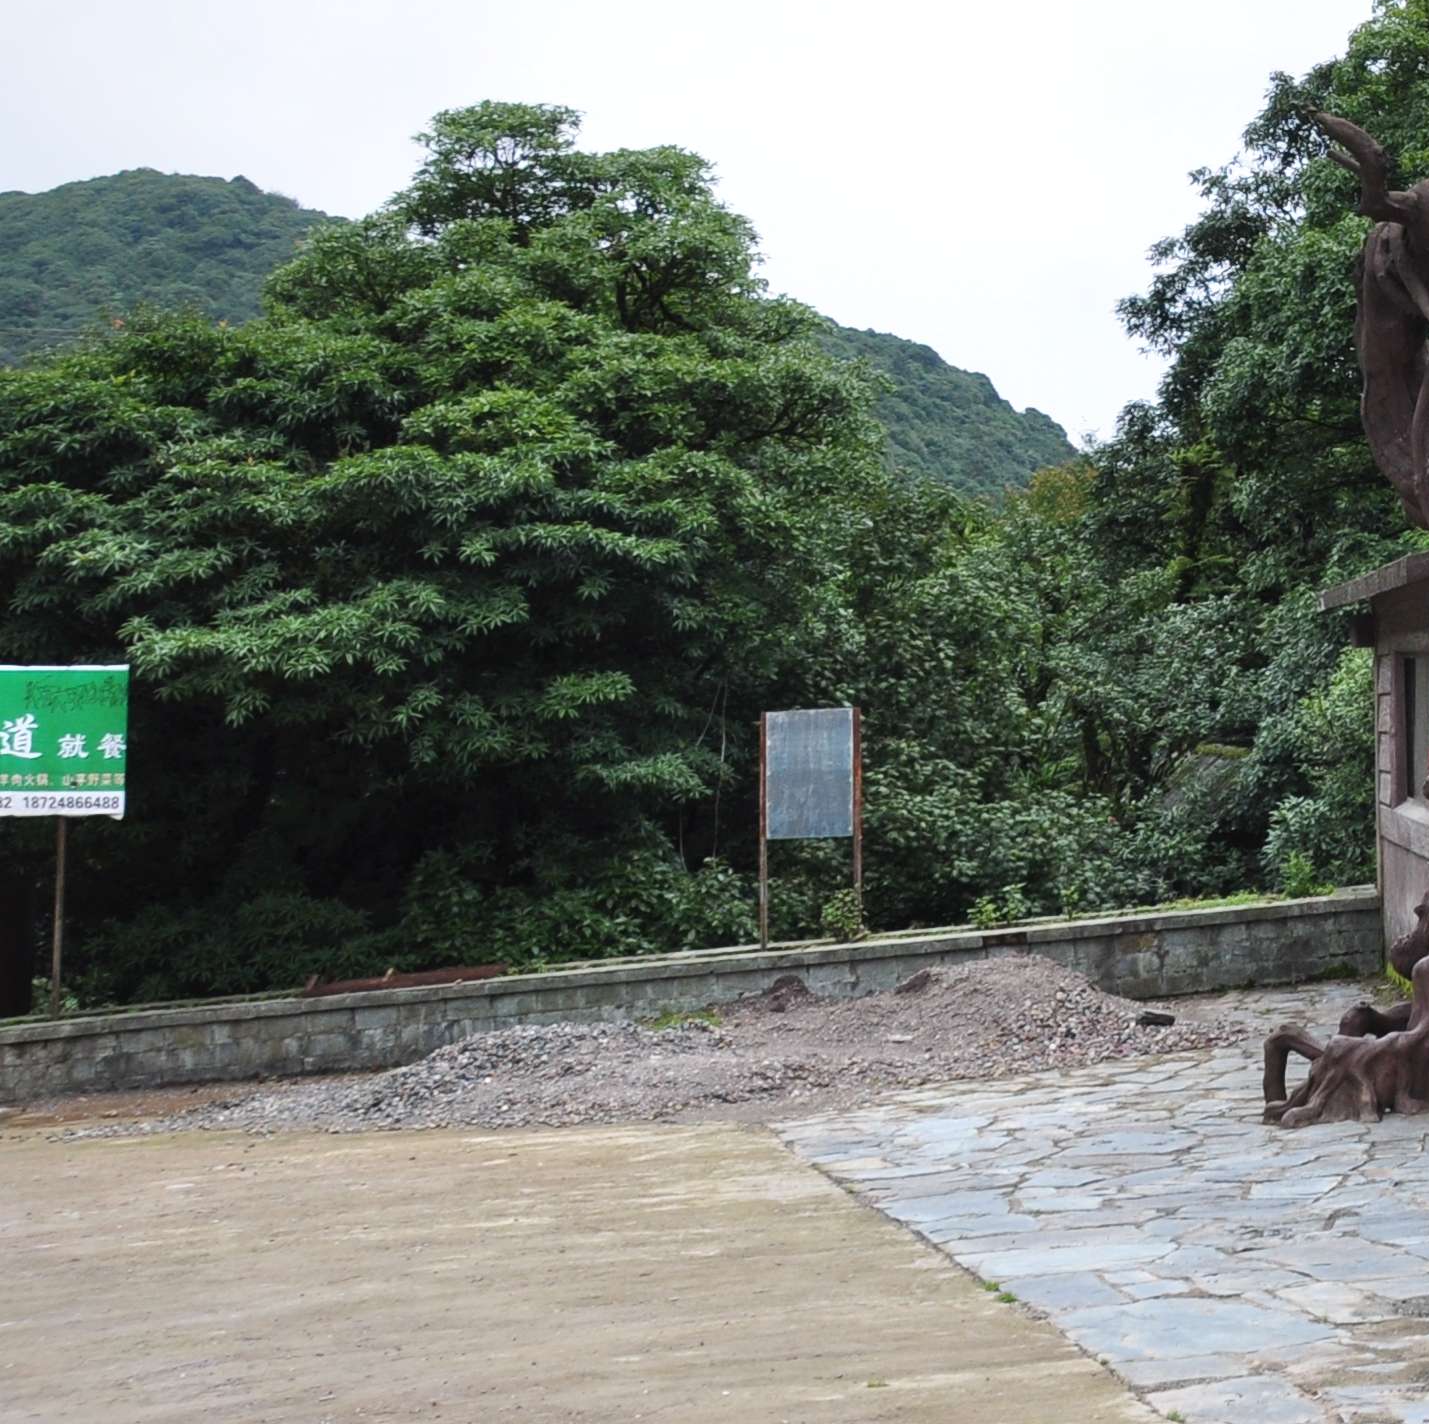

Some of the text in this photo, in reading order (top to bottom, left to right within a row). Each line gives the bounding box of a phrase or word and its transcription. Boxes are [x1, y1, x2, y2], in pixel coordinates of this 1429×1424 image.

[0, 713, 127, 759] 道 就餐
[23, 795, 120, 810] 18724866488
